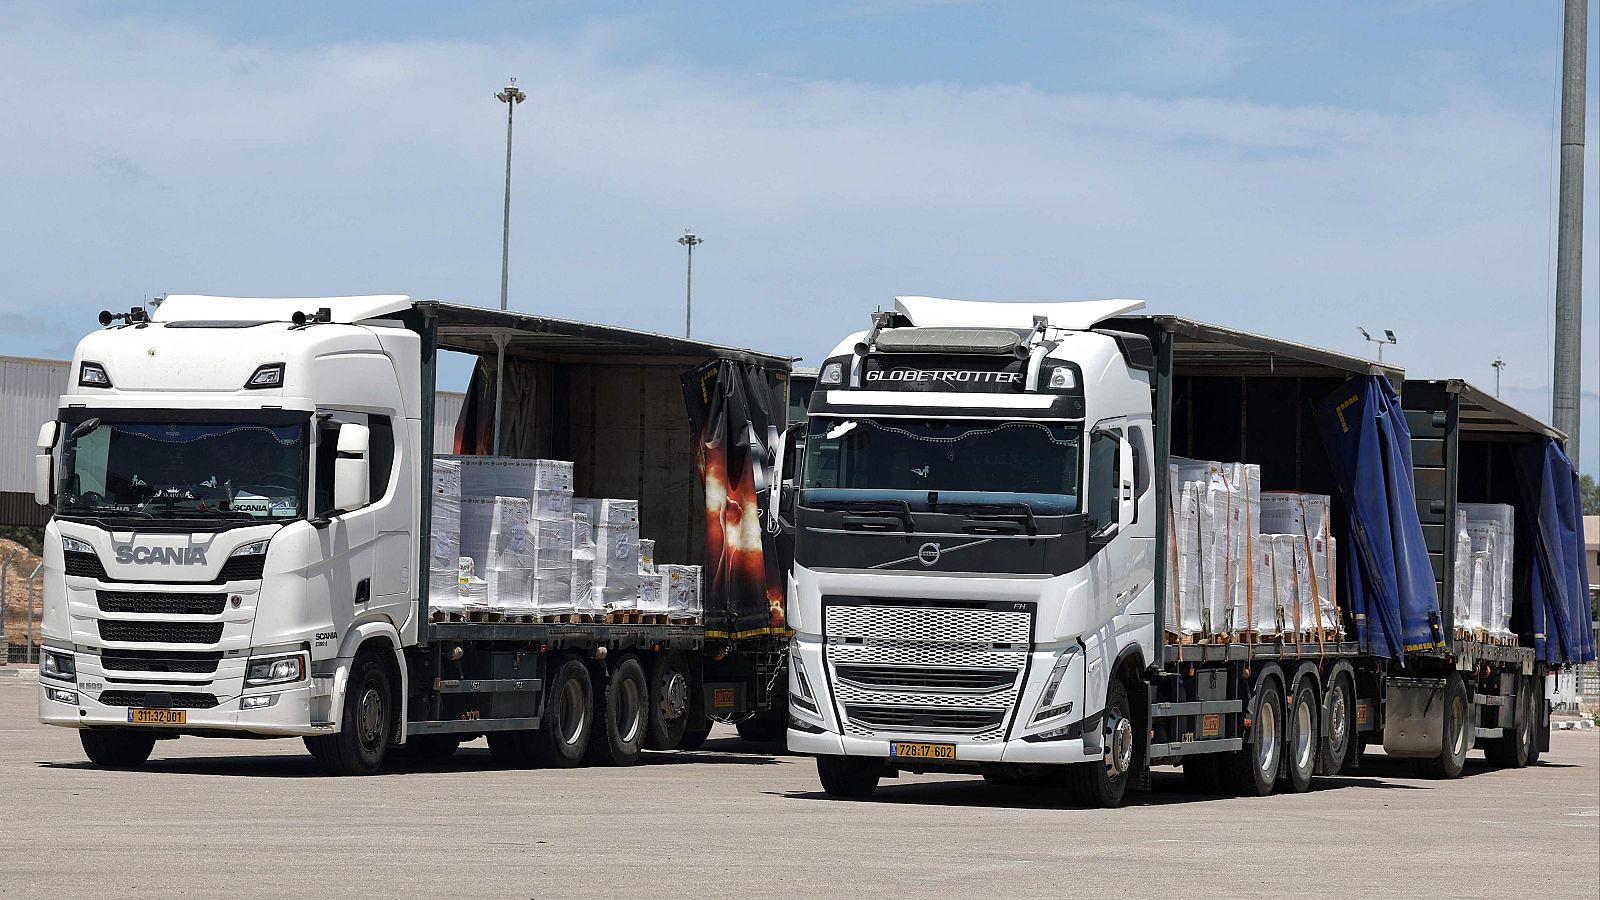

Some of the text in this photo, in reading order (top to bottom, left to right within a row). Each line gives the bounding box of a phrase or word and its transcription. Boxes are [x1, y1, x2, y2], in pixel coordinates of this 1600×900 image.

[865, 370, 1024, 384] GLOBETROTTER
[233, 504, 267, 512] SCANIA
[115, 545, 208, 567] SCANIA
[315, 631, 338, 641] SCANIA
